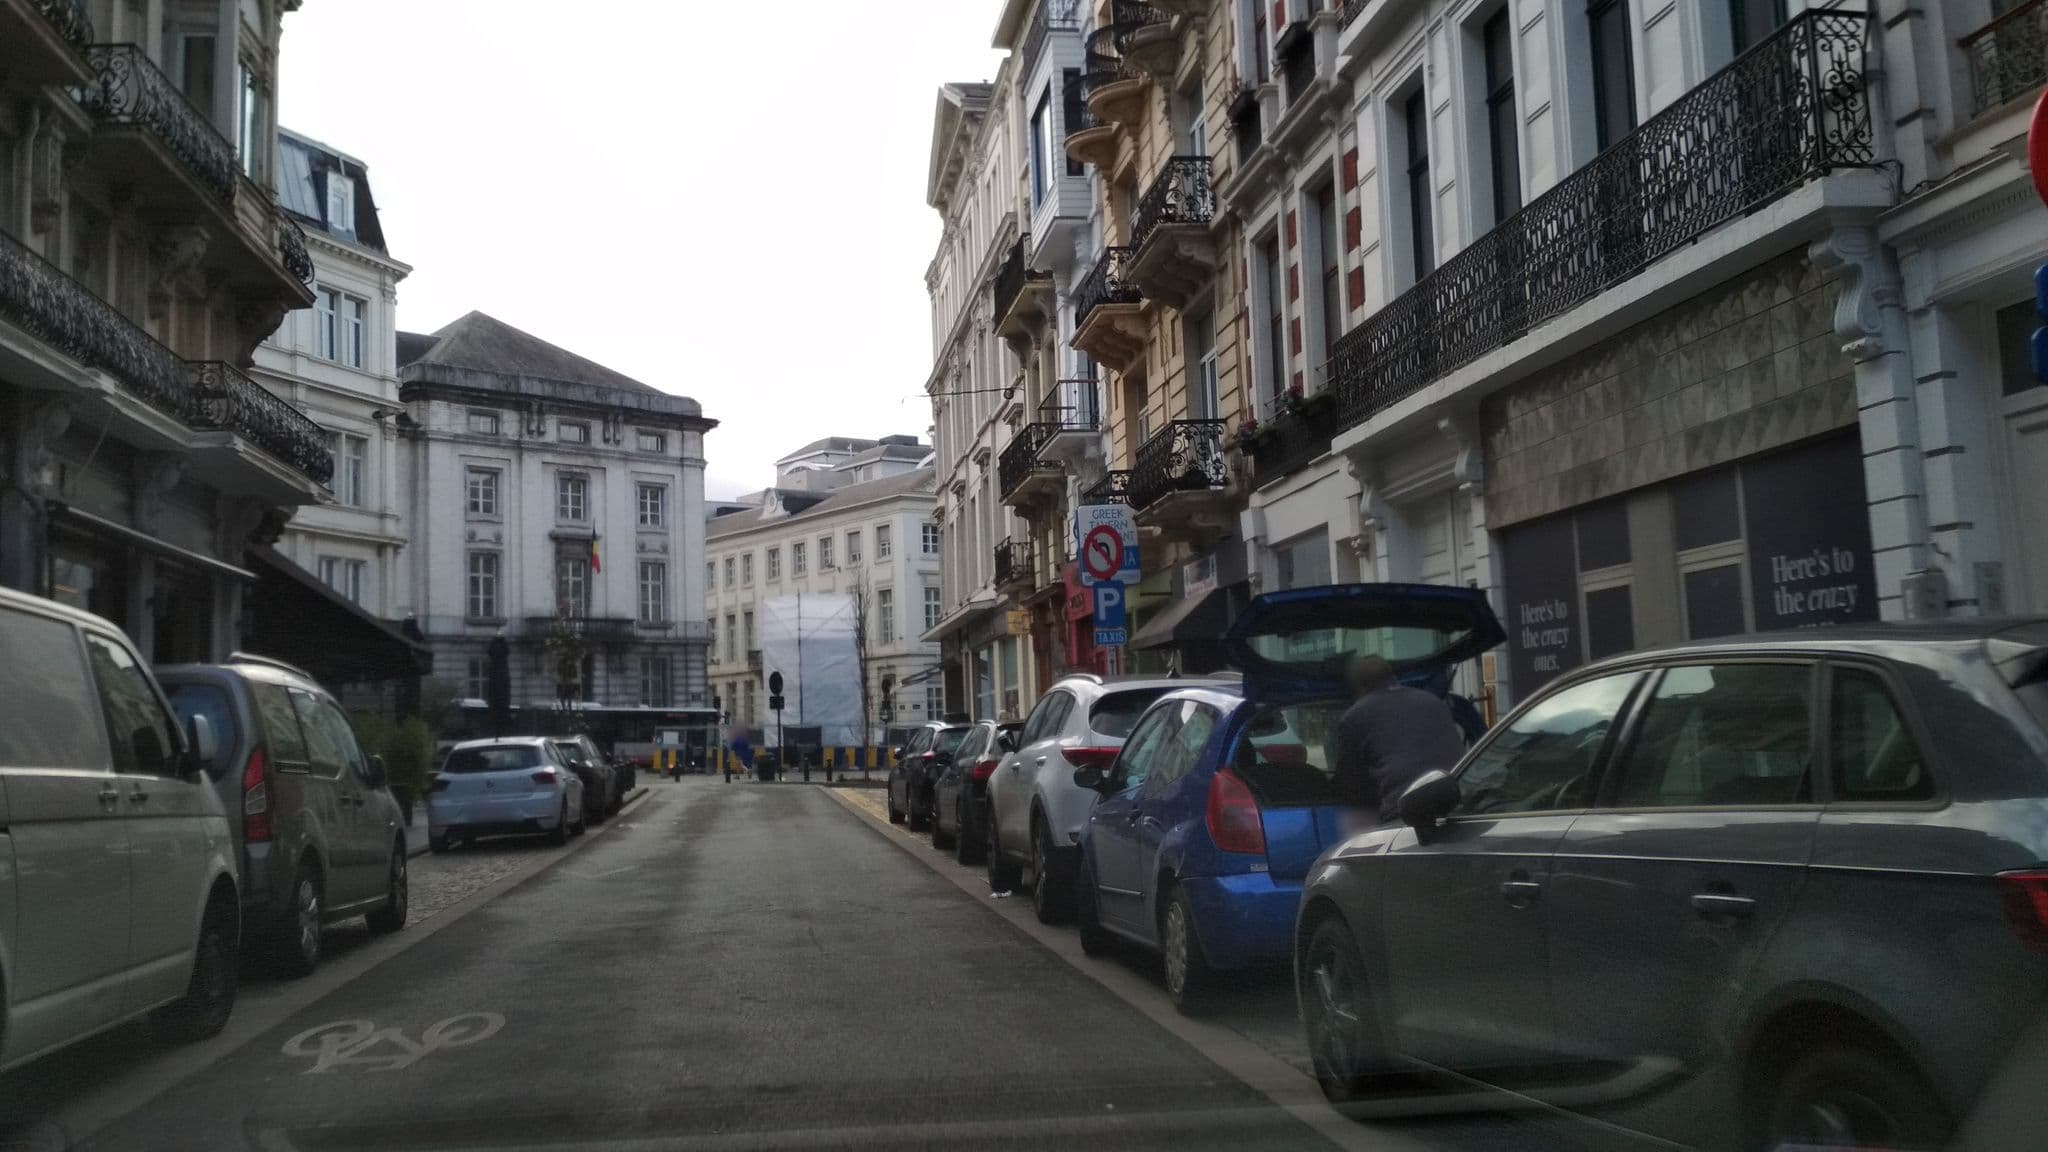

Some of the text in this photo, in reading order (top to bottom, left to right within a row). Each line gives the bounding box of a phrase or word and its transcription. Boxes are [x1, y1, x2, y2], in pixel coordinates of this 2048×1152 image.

[1092, 508, 1124, 519] GREEK
[1771, 546, 1855, 583] Here's to
[1097, 587, 1120, 621] P
[1521, 599, 1568, 624] Here's to
[1775, 584, 1857, 615] the crazy
[1098, 631, 1125, 642] TAXIS
[1522, 626, 1569, 648] the crazy
